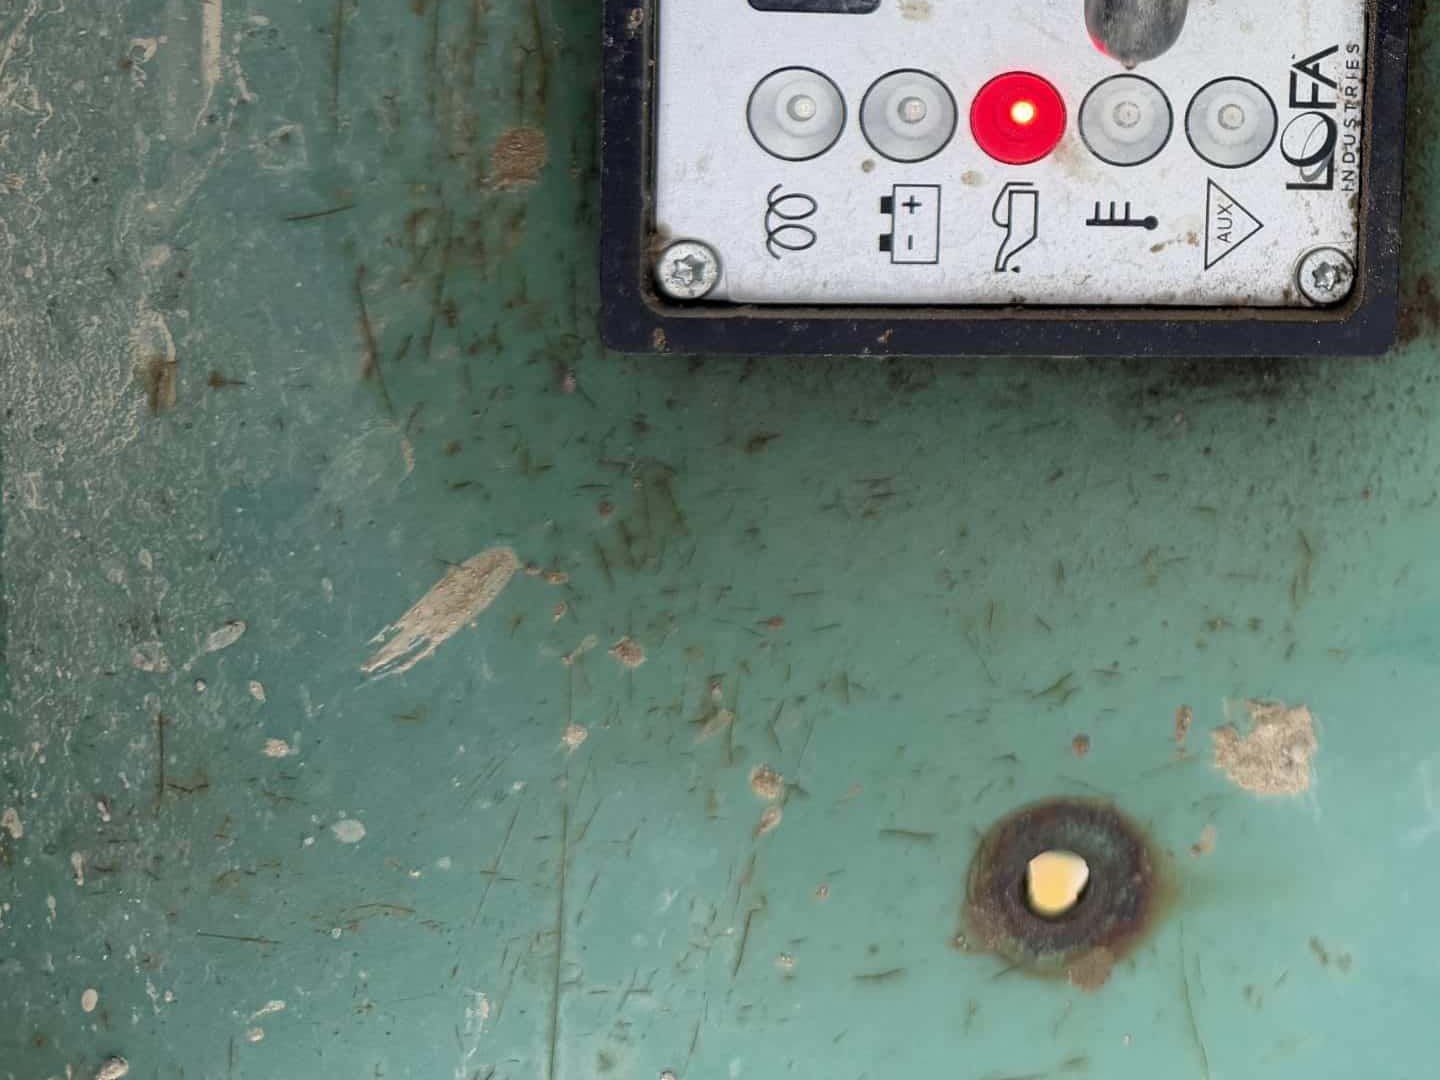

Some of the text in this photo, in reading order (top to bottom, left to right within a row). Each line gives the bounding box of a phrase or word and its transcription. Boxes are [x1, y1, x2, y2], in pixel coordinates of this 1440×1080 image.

[1279, 43, 1339, 191] LOFA
[1341, 42, 1361, 193] INDUSTRIES
[1216, 203, 1233, 244] AUX
